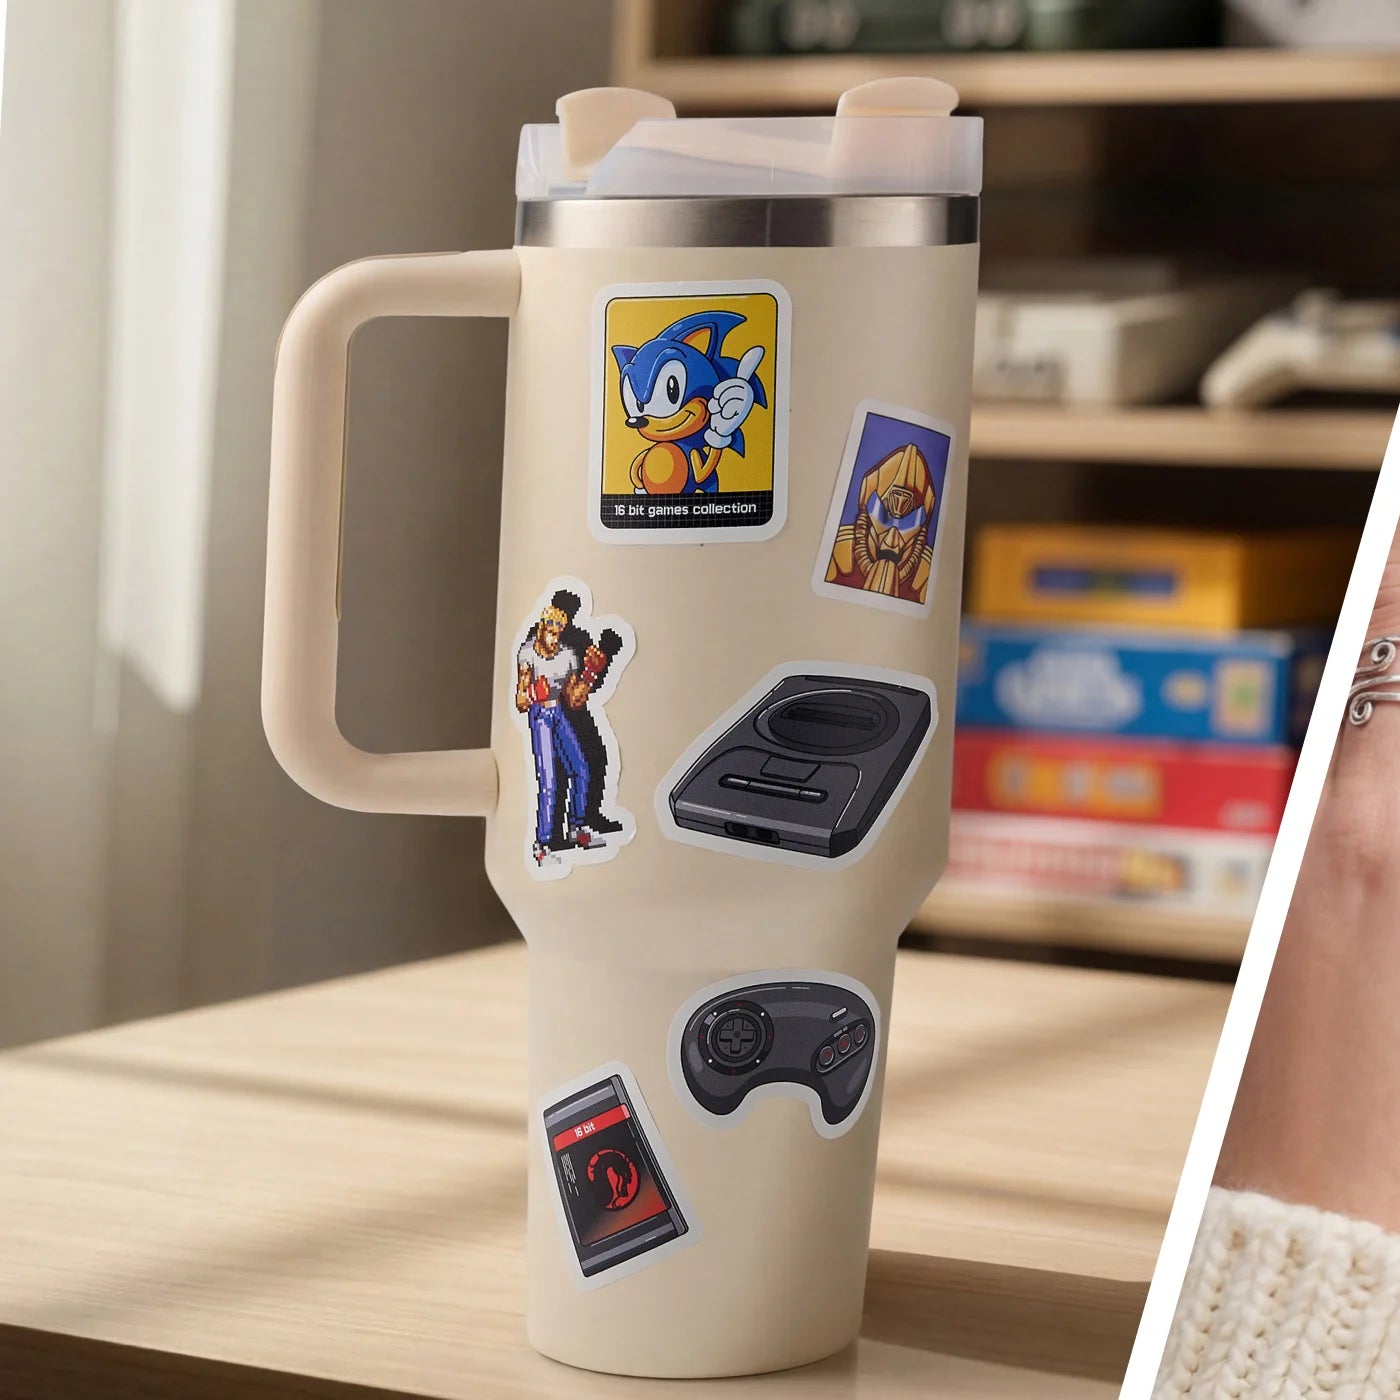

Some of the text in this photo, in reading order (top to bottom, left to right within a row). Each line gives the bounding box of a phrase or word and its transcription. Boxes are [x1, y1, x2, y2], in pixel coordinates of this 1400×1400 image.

[614, 502, 757, 518] 16 bit games collection
[583, 1121, 596, 1134] bit
